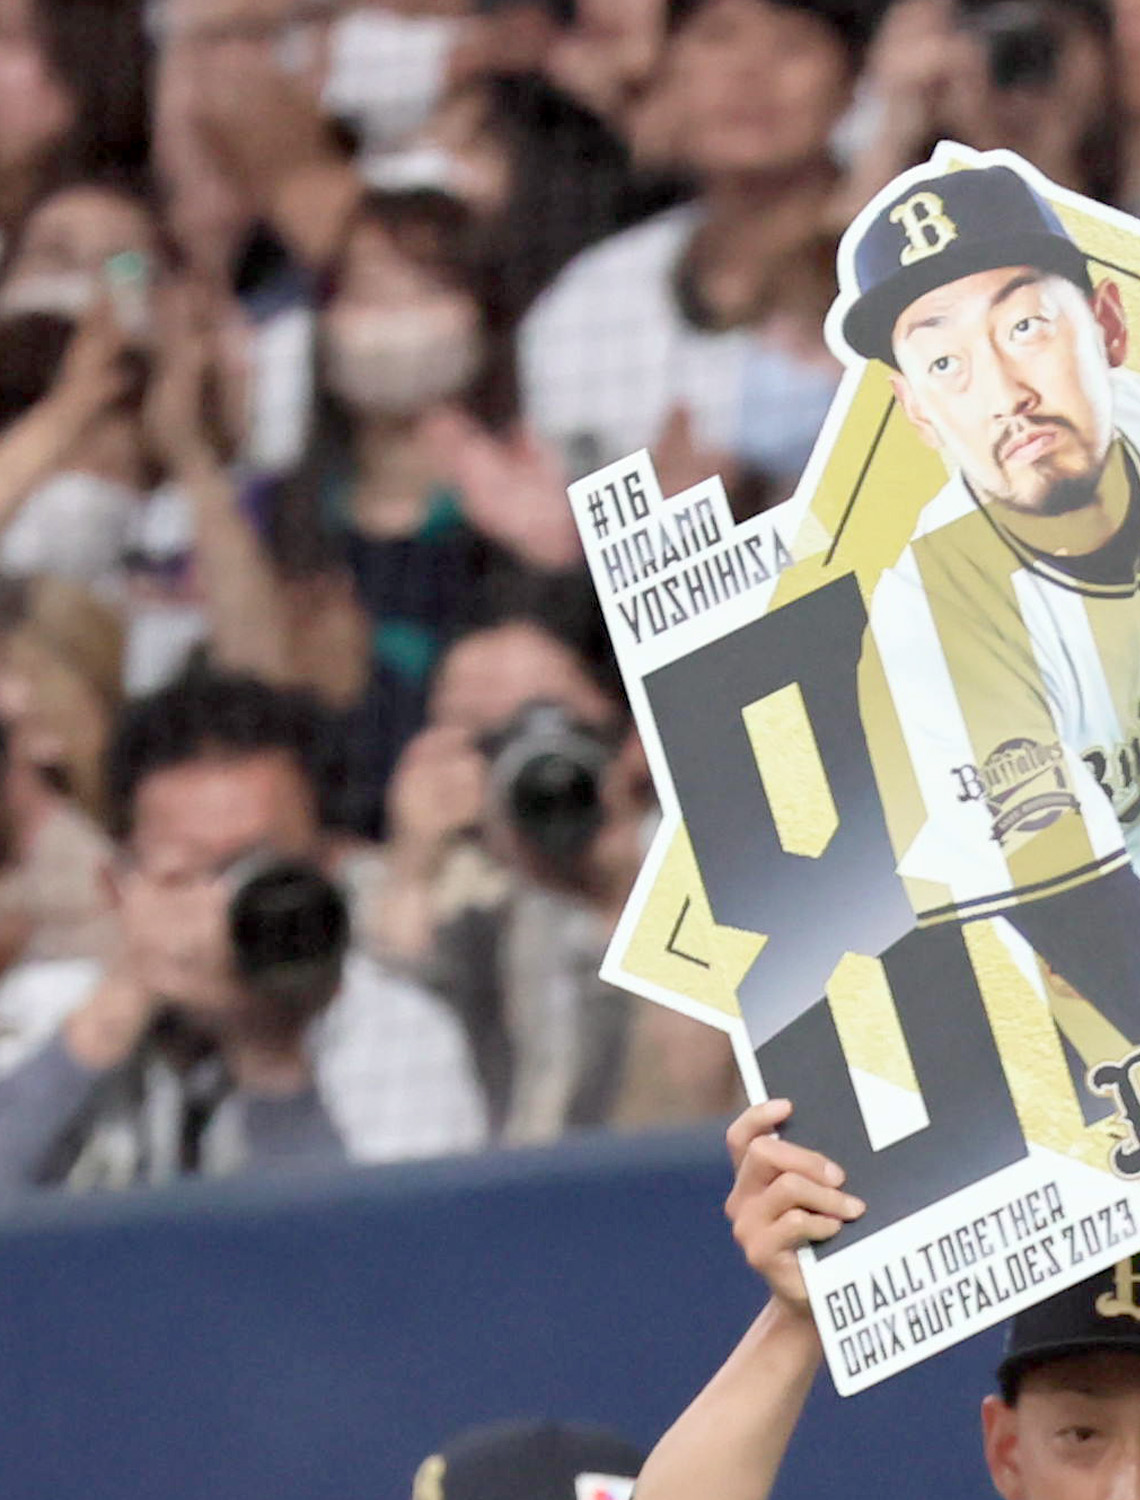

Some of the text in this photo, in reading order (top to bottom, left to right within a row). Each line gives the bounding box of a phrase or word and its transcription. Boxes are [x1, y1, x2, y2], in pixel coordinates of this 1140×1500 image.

[588, 471, 651, 540] #16
[599, 497, 723, 594] HIRANO
[616, 525, 795, 644] YOSHIHISA
[826, 1282, 865, 1333] GO
[838, 1198, 1138, 1379] ORIX BUFFALOES 2023
